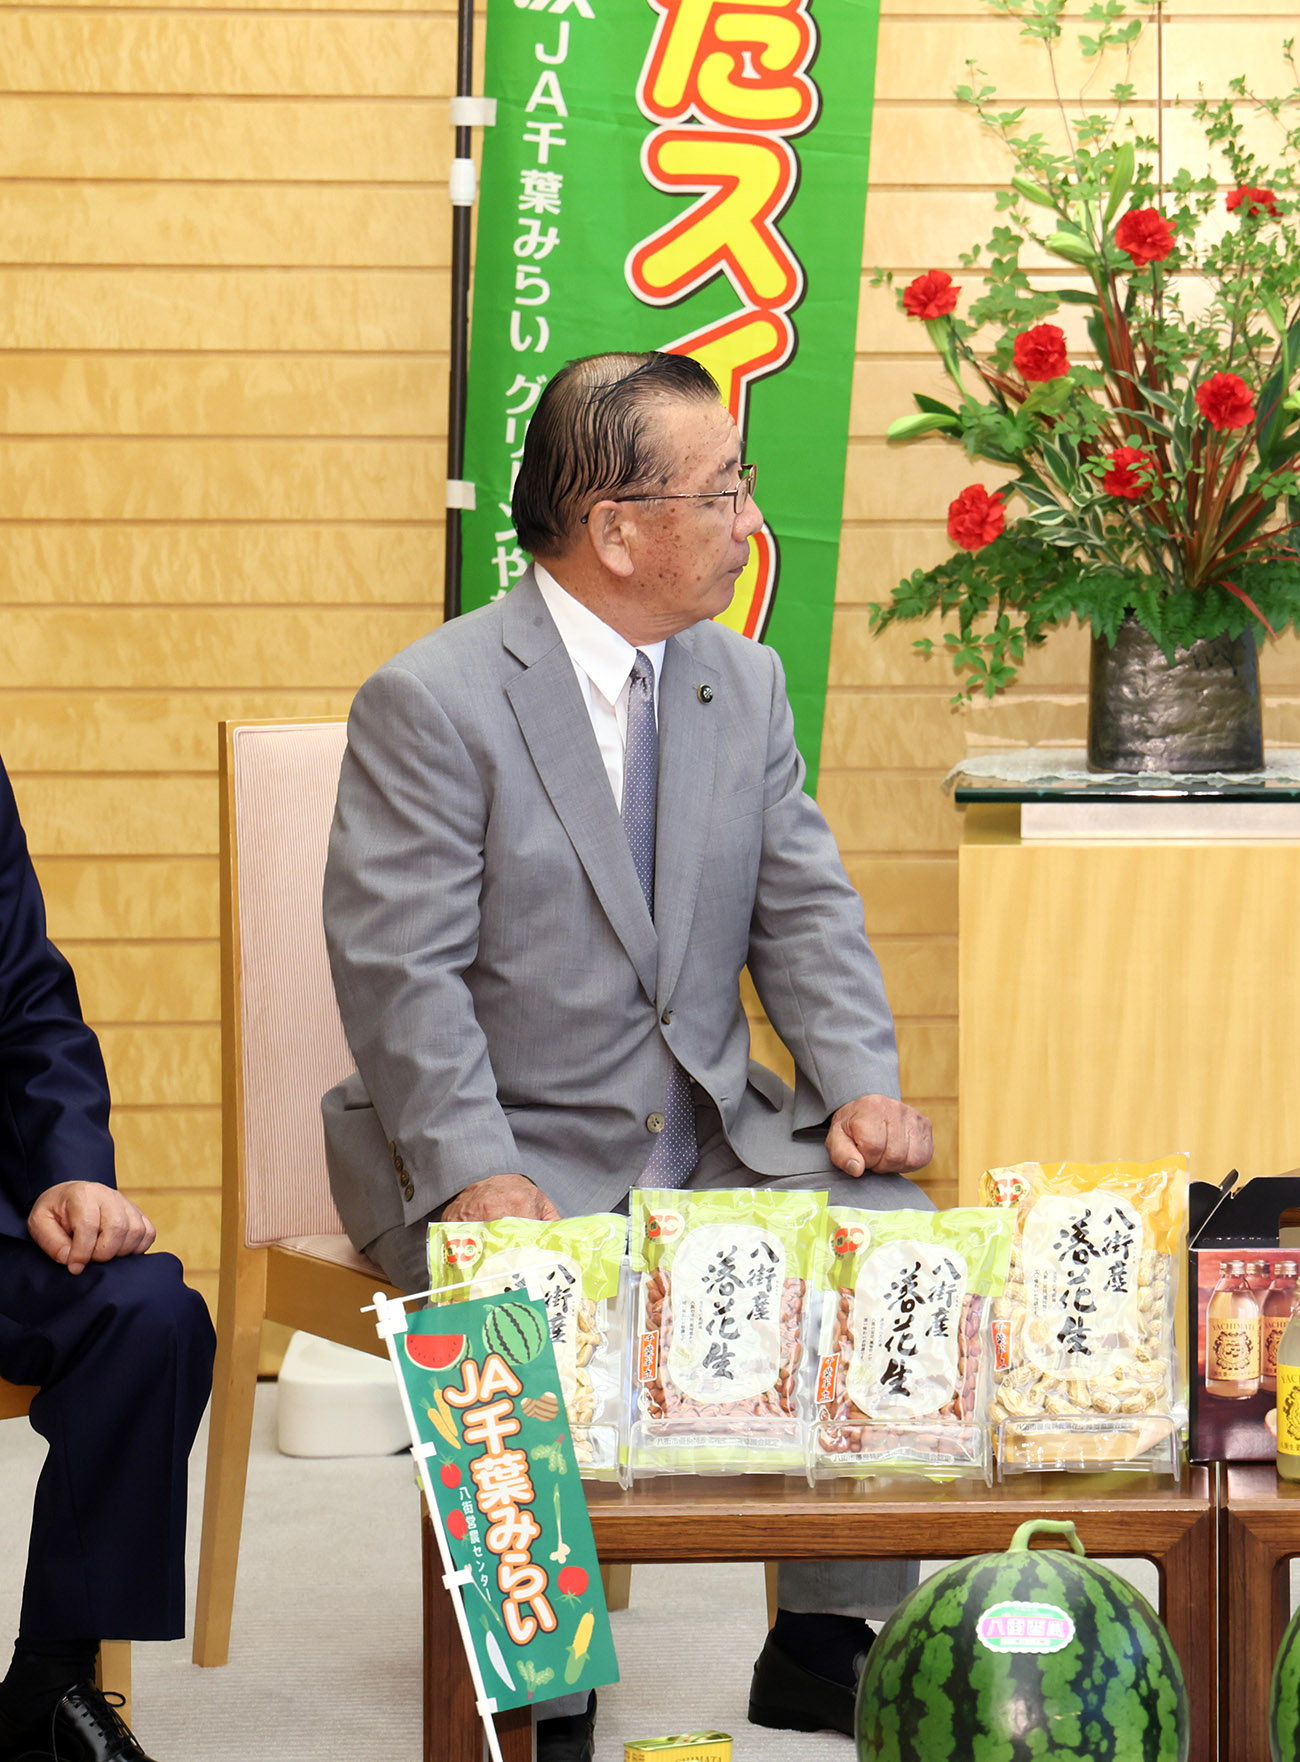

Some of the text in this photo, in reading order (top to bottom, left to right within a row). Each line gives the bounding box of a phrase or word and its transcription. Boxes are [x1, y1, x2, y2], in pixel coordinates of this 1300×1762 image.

[511, 20, 570, 353] JA千葉みらい
[624, 0, 820, 648] たスイ
[701, 1244, 746, 1381] 落花生
[746, 1241, 780, 1321] 八街産
[924, 1257, 962, 1338] 八街産
[1053, 1208, 1102, 1356] 落花生
[1102, 1207, 1136, 1294] 八街産
[880, 1260, 926, 1397] 落花生
[444, 1354, 557, 1645] JA千葉みらい
